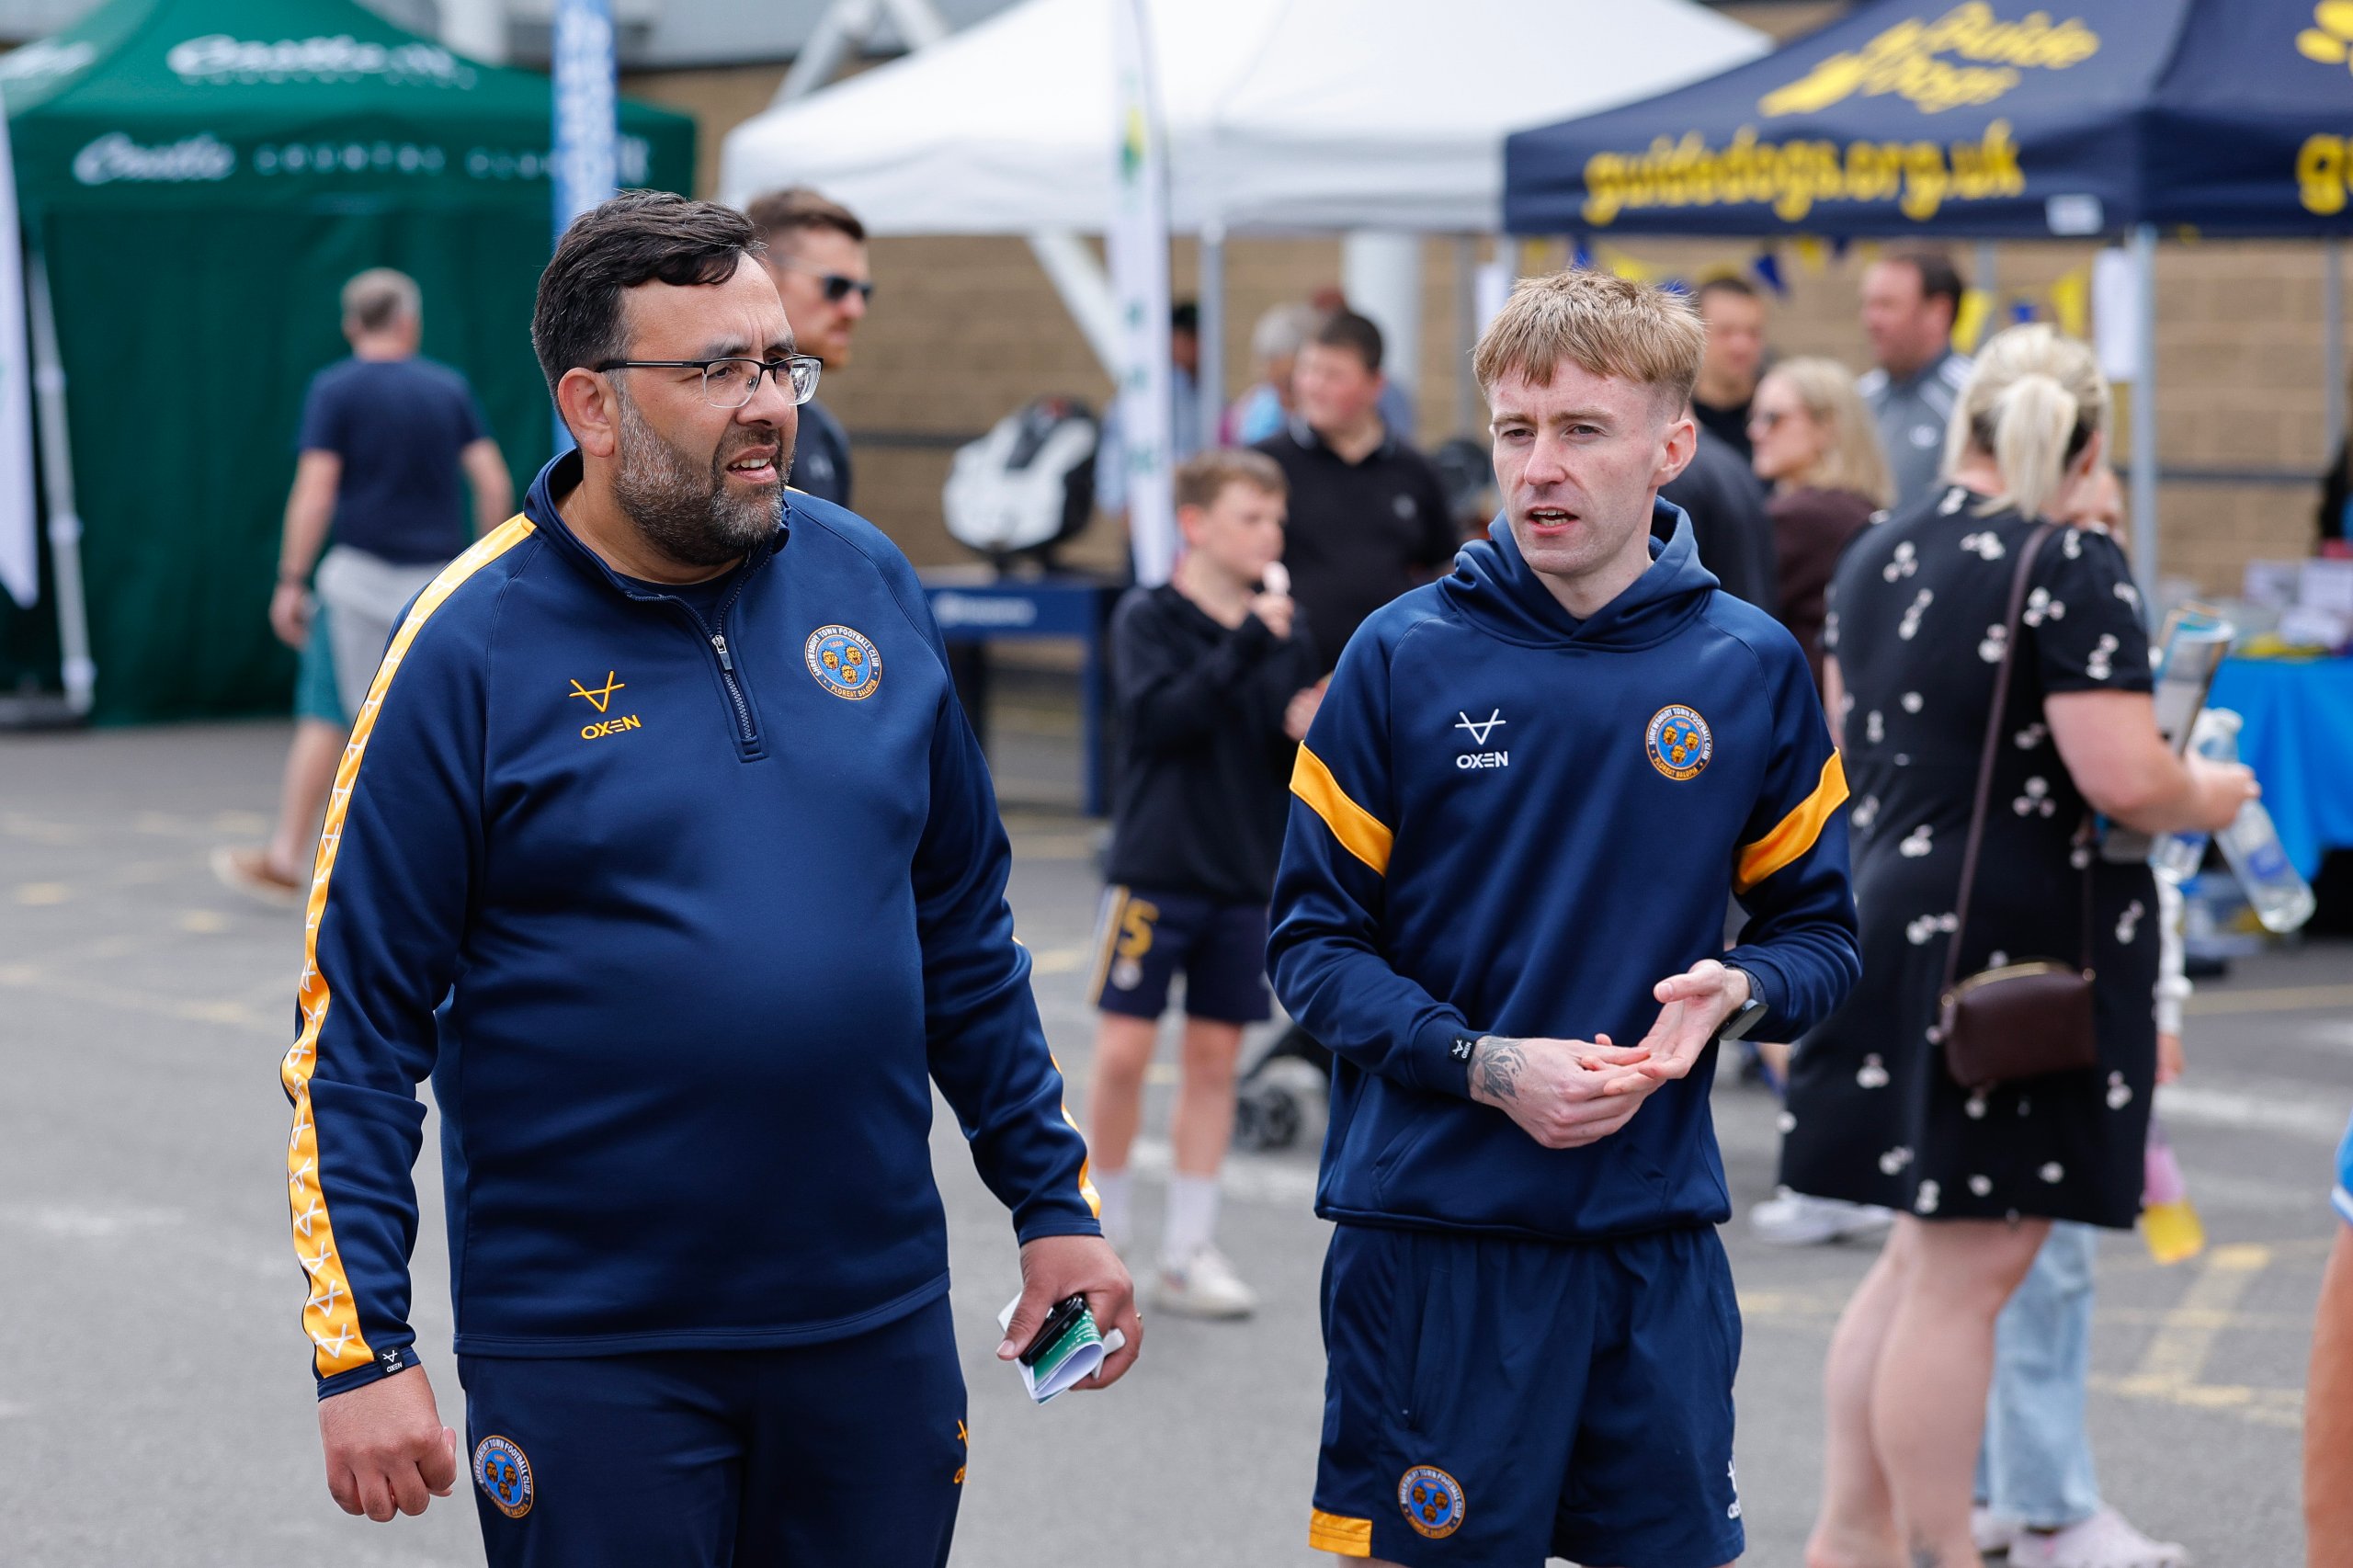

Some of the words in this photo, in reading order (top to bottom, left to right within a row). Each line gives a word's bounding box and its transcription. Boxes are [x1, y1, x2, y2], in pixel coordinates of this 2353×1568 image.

[1583, 118, 2025, 226] guidedogs.org.uk
[807, 632, 823, 676] SHREWSBURY
[818, 627, 837, 638] TOWN
[838, 628, 871, 650] FOOTBALL
[868, 649, 880, 667] CLUB
[581, 714, 642, 740] OXEN
[1648, 709, 1673, 745] SHREWSBURY
[1673, 708, 1690, 717] TOWN
[1689, 712, 1710, 742] FOOTBALL
[1701, 742, 1711, 760] CLUB
[1456, 750, 1508, 769] OXEN
[386, 1361, 403, 1373] OXEN
[504, 1442, 529, 1475] FOOTBALL
[522, 1475, 531, 1494] CLUB
